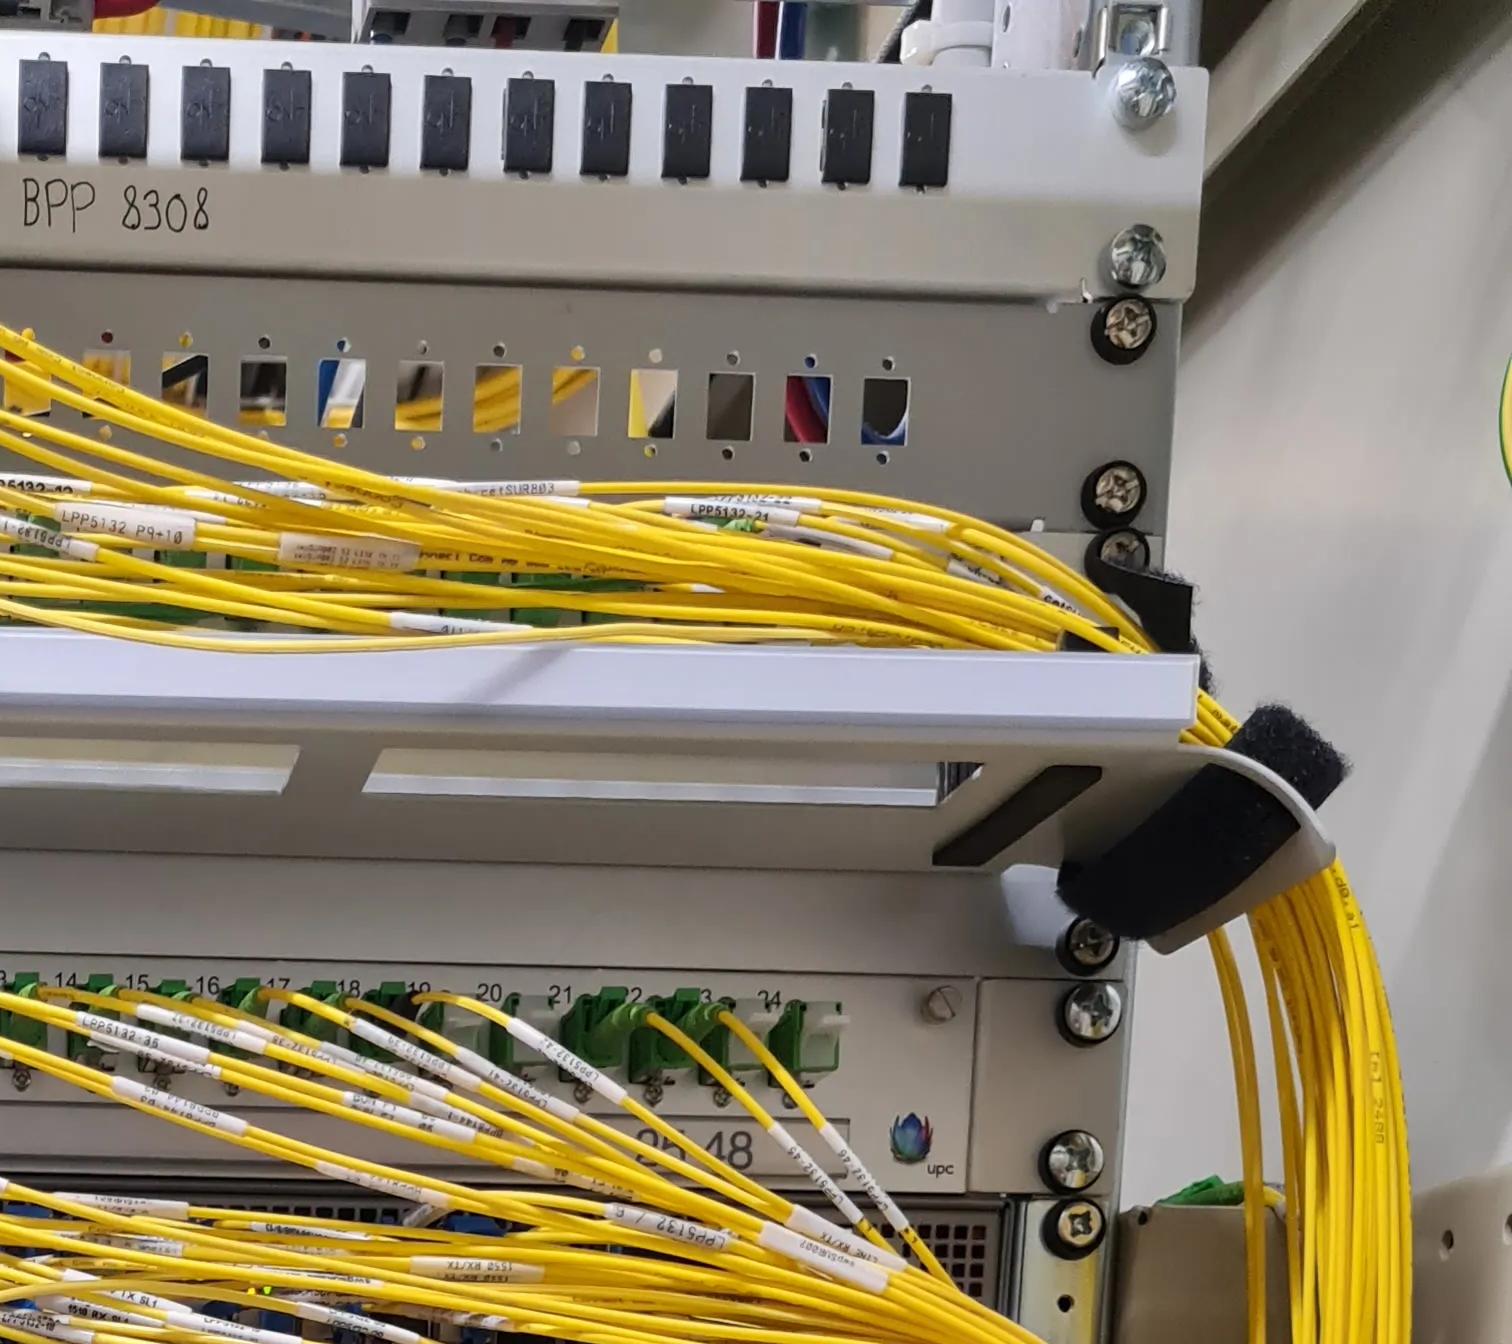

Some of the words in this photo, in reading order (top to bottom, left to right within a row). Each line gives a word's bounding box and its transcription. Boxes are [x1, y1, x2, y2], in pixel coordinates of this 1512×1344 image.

[23, 177, 95, 232] BPP
[123, 184, 210, 232] 8308
[59, 509, 127, 534] LPP5132
[55, 972, 81, 990] 14
[126, 974, 153, 993] 15
[193, 976, 224, 998] 16
[474, 983, 502, 1002] 20
[547, 985, 571, 1008] 21
[635, 1127, 753, 1171] 2548
[927, 1161, 954, 1178] upc
[656, 1215, 726, 1248] LPP5132
[445, 1258, 481, 1270] RX/TX
